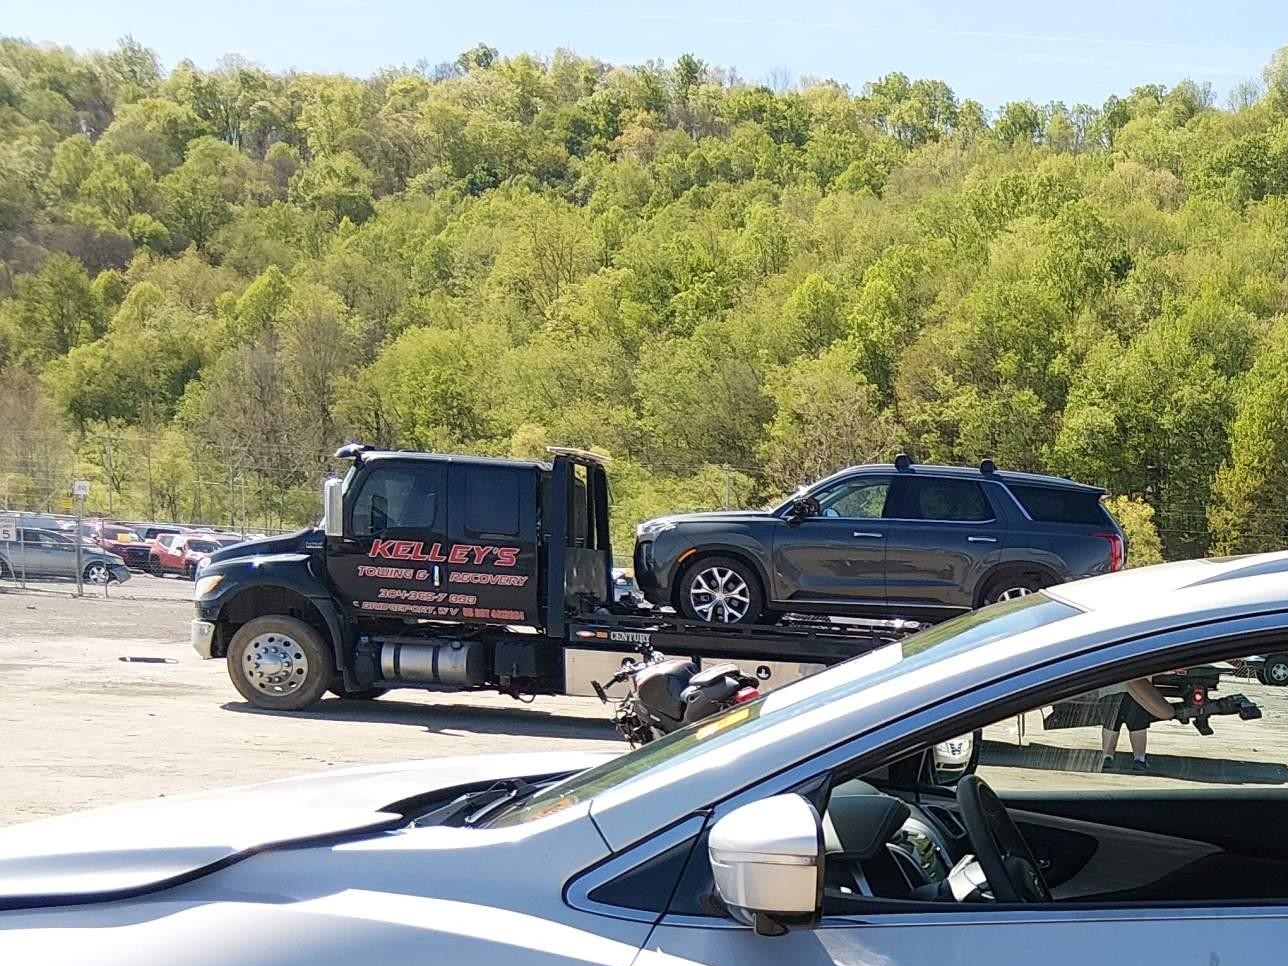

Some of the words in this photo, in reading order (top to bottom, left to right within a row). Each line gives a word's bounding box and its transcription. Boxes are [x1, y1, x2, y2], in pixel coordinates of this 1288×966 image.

[2, 530, 10, 539] 5
[368, 539, 521, 567] KELLEY'S
[357, 565, 415, 580] TOWING
[415, 569, 430, 582] &
[448, 571, 529, 587] RECOVERY
[610, 631, 651, 642] CENTURY
